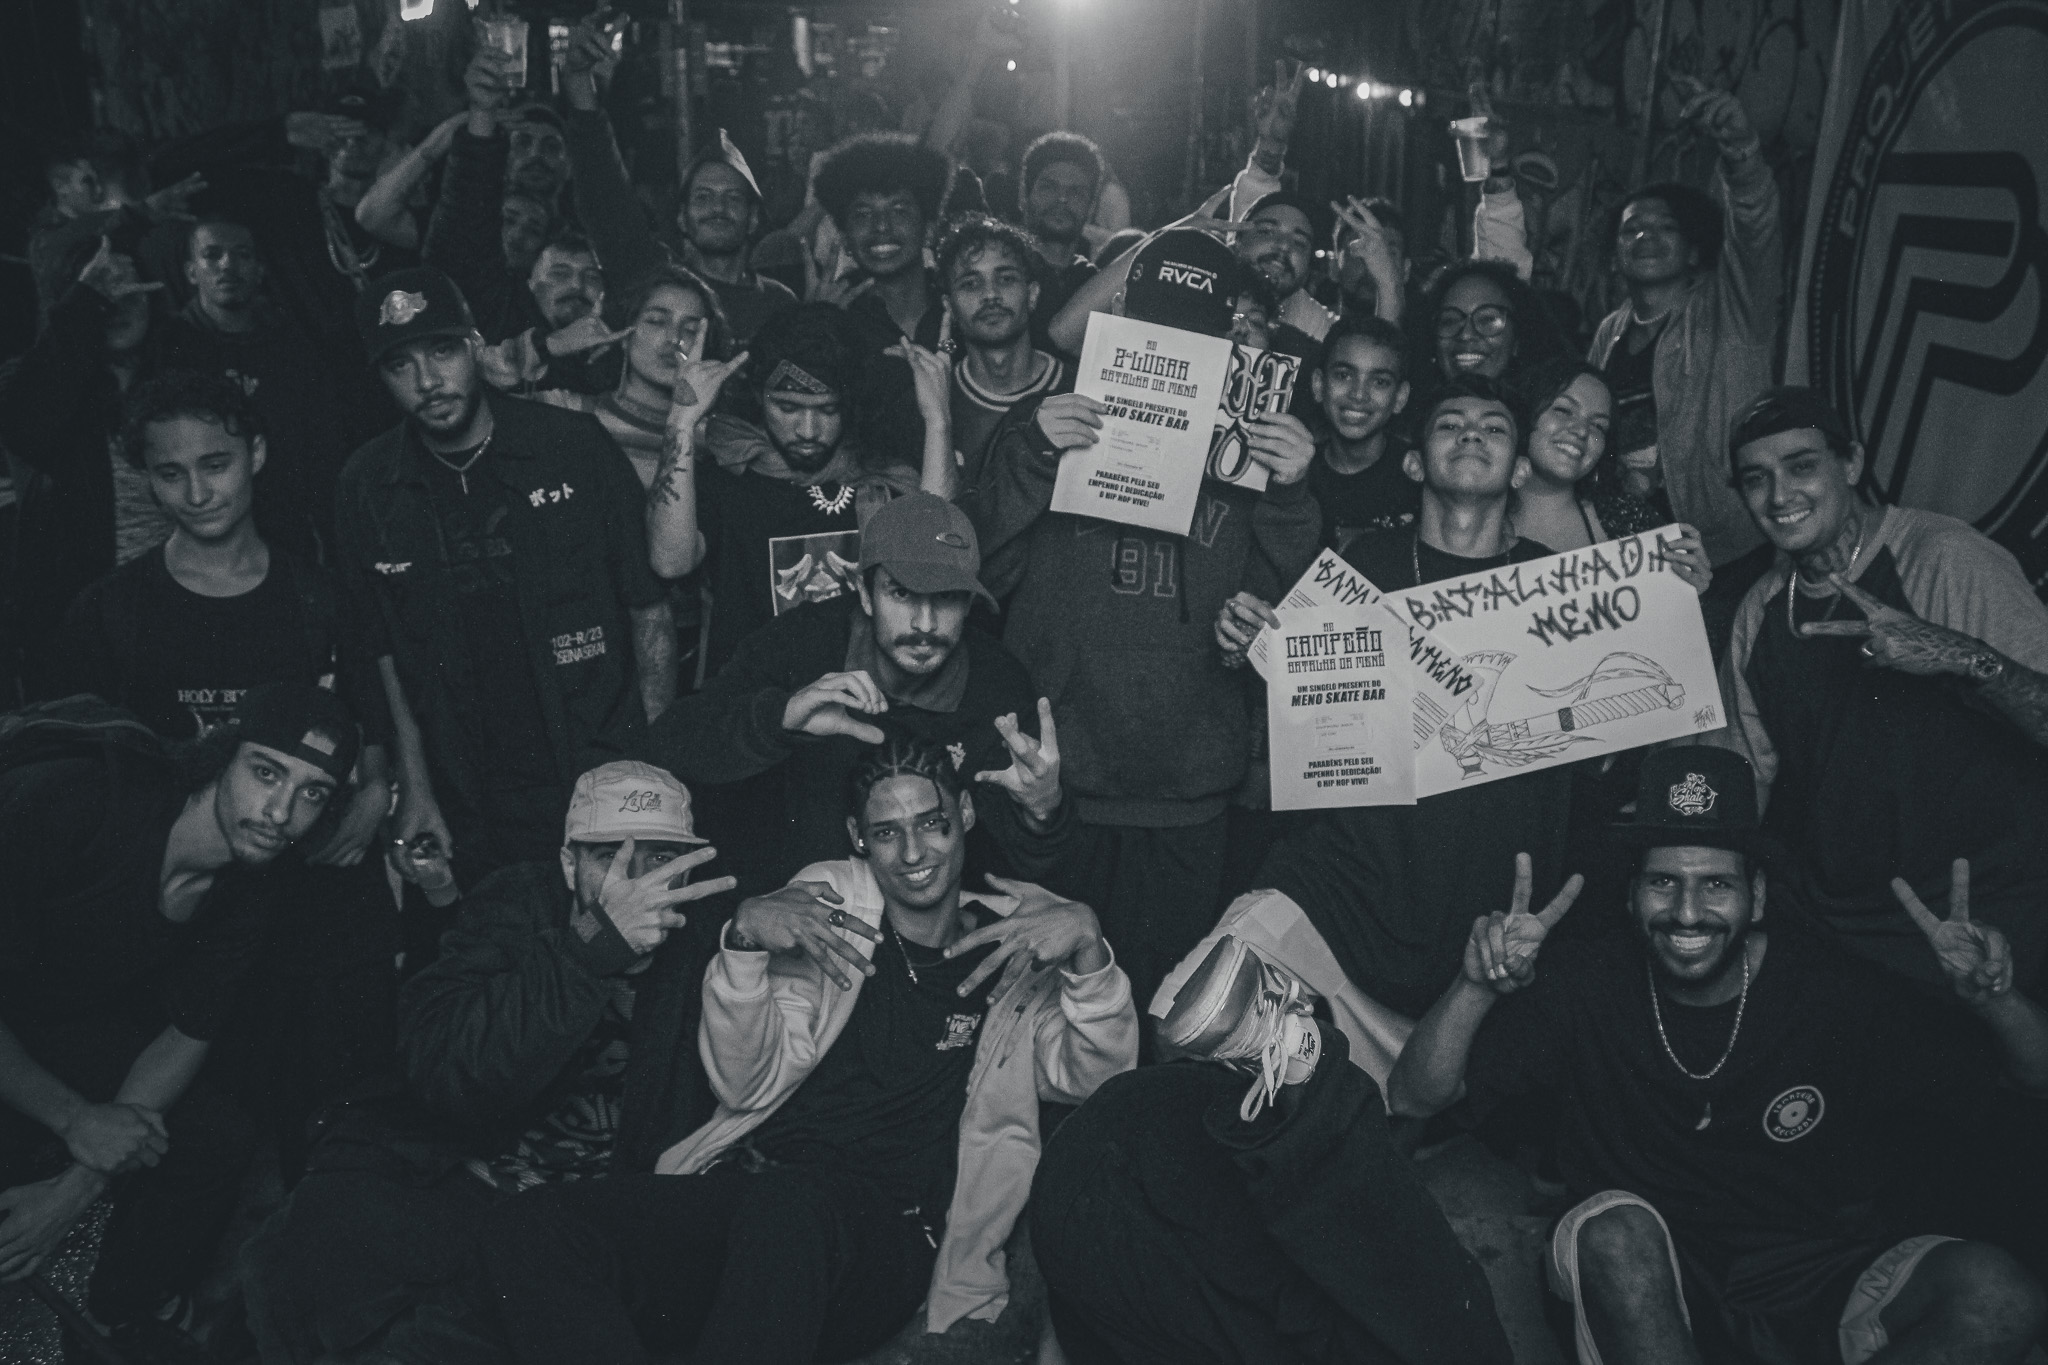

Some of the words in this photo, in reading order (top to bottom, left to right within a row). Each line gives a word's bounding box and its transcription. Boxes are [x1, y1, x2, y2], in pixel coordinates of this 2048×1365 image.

[1839, 0, 1951, 238] PROJE
[1158, 266, 1213, 294] RVCA
[1130, 351, 1191, 381] LUGAR
[1100, 368, 1150, 389] BATALHA
[1151, 378, 1167, 392] DA
[1104, 394, 1116, 404] UM
[1116, 396, 1144, 409] SINGELO
[1144, 402, 1178, 416] PRESENTE
[1178, 408, 1188, 418] DO
[1104, 403, 1128, 418] ENO
[1128, 408, 1165, 426] SKATE
[1165, 416, 1190, 431] BAR
[1088, 478, 1120, 491] EMPENHO
[1120, 484, 1125, 493] E
[1125, 485, 1166, 501] DEDICAÇÃO!
[1130, 476, 1147, 488] PELO
[1147, 480, 1161, 490] SEU
[1099, 490, 1105, 499] O
[1105, 491, 1118, 501] HIP
[1117, 494, 1132, 504] HOP
[1132, 498, 1151, 508] VIVE!
[1405, 547, 1620, 631] BATALHA
[1527, 585, 1641, 647] MENO
[1285, 626, 1383, 659] CAMPEÃO
[1287, 658, 1337, 674] BATALHA
[1339, 656, 1353, 670] DA
[178, 688, 217, 704] HOLY
[1291, 693, 1323, 707] MENO
[1325, 690, 1361, 705] SKATE
[1362, 688, 1386, 701] BAR
[1297, 685, 1308, 693] UM
[1309, 682, 1337, 693] SINGELO
[1338, 680, 1370, 690] PRESENTE
[1371, 679, 1382, 688] DO
[1303, 770, 1334, 779] EMPENHO
[1336, 769, 1340, 777] E
[1341, 766, 1382, 777] DEDICAÇÃO!
[1344, 757, 1360, 767] PELO
[1361, 757, 1374, 765] SEU
[1317, 780, 1322, 788] O
[1323, 779, 1335, 788] HIP
[1336, 778, 1350, 787] HOP
[1351, 777, 1369, 786] VIVE!
